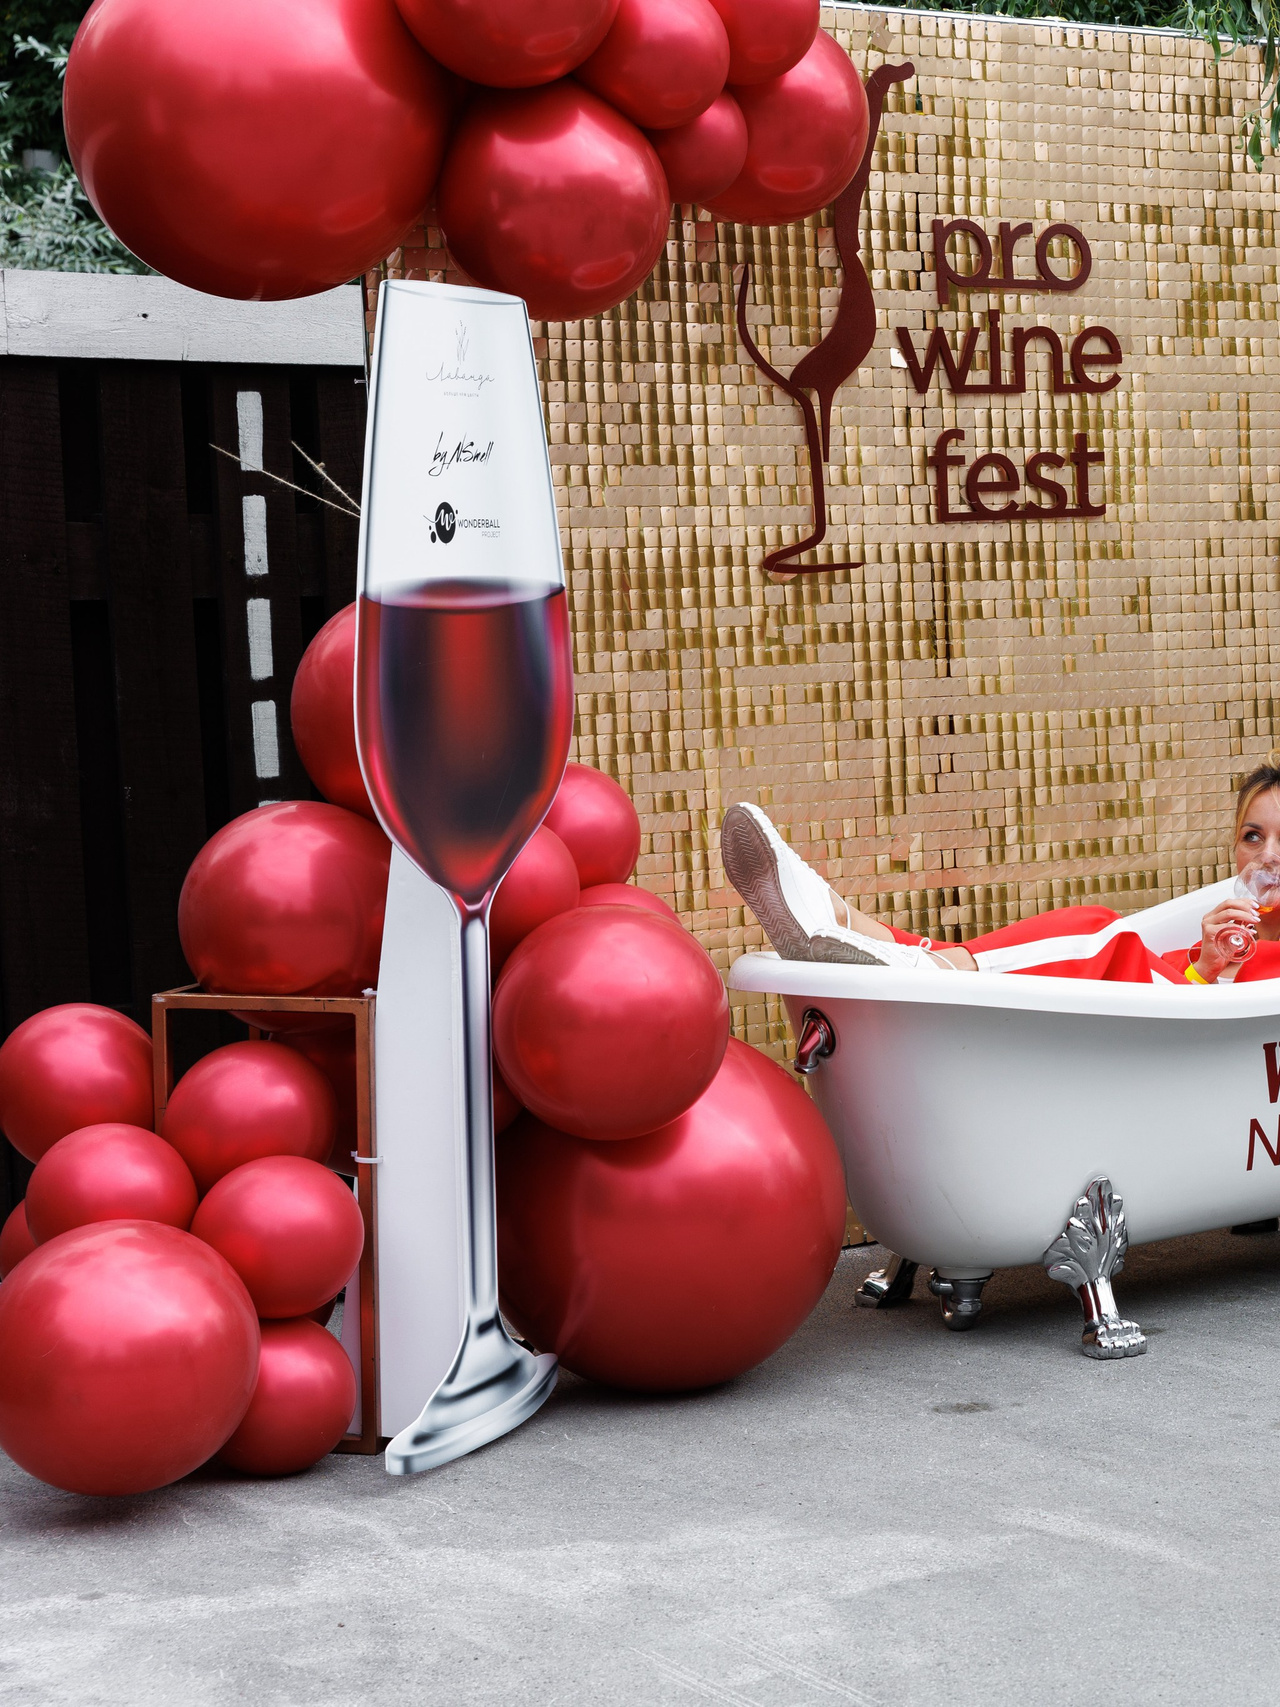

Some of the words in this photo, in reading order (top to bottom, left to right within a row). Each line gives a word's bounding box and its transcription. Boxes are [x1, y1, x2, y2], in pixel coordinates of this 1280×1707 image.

[932, 218, 1092, 304] pro
[896, 308, 1122, 393] wine
[428, 431, 448, 477] by
[928, 428, 1107, 522] fest
[457, 519, 501, 528] WONDERBALL
